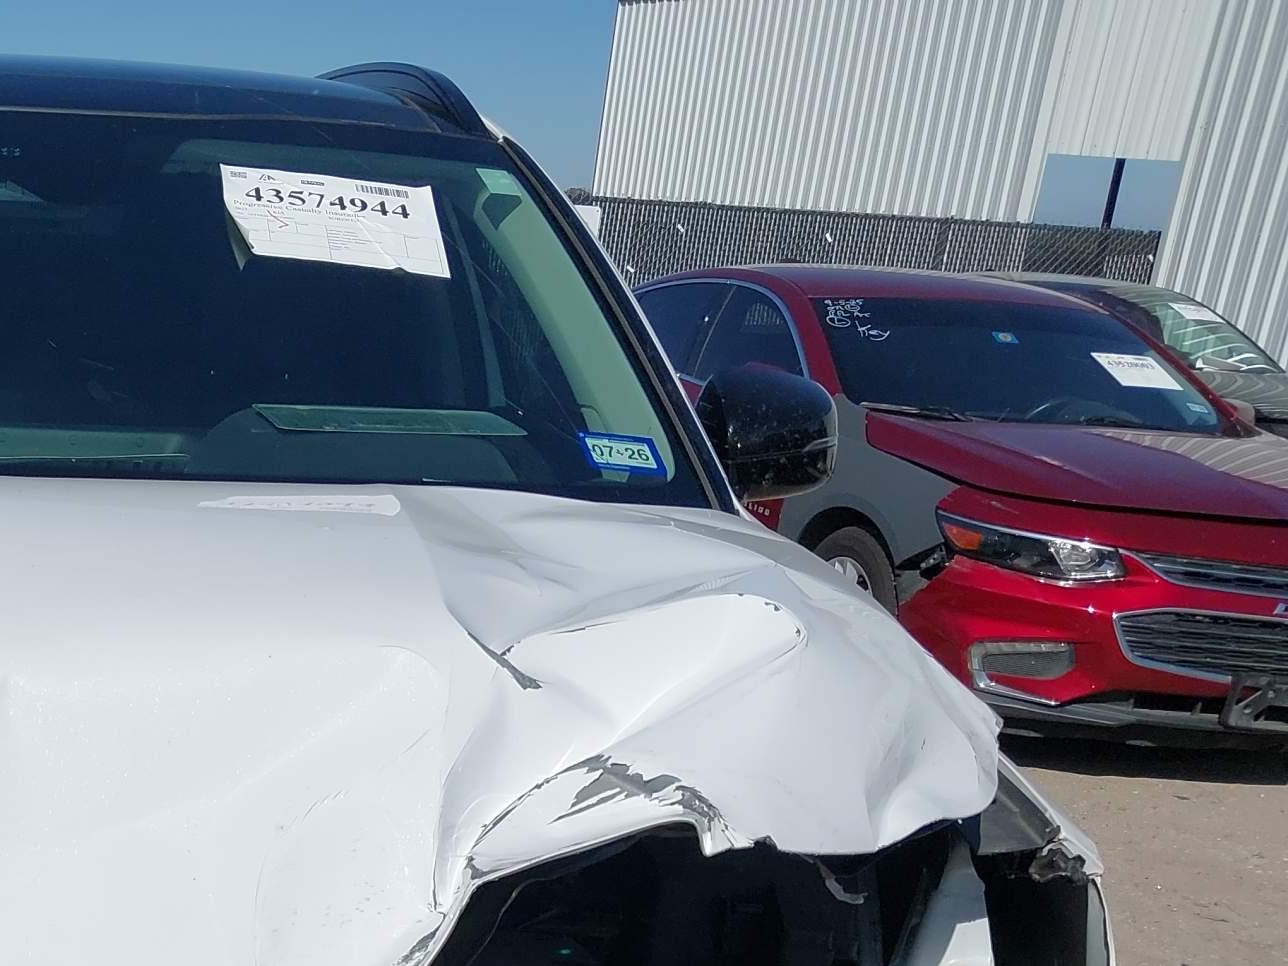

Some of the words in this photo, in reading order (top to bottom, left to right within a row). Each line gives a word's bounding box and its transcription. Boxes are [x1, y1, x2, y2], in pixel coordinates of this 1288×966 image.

[245, 186, 411, 220] 43574944
[591, 444, 614, 458] 07
[624, 447, 650, 462] 26
